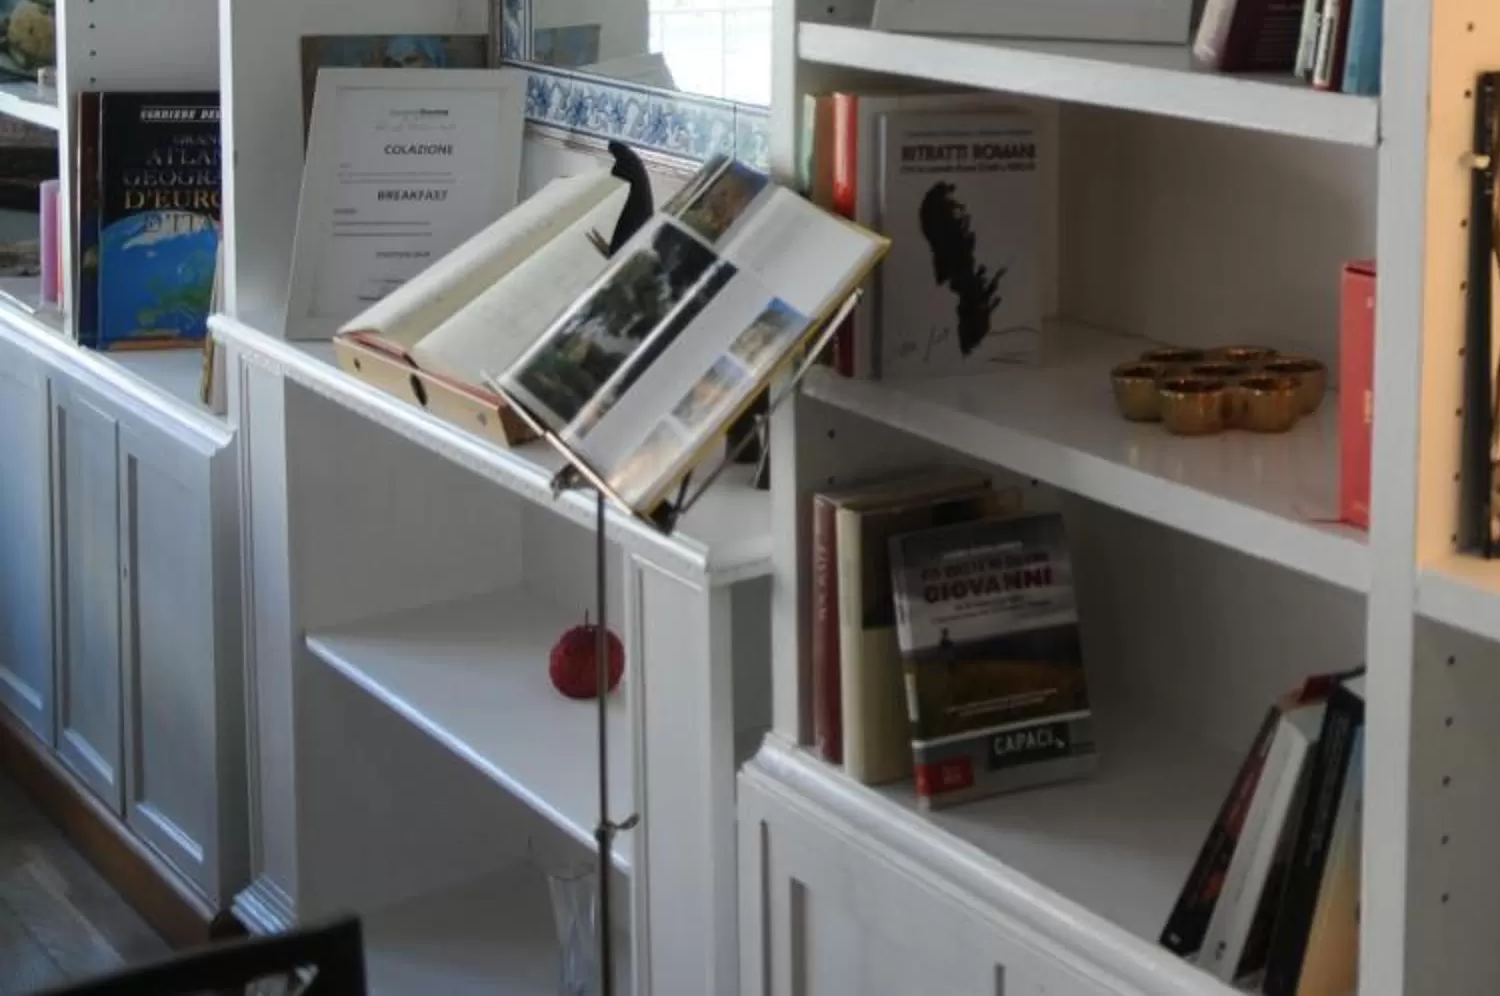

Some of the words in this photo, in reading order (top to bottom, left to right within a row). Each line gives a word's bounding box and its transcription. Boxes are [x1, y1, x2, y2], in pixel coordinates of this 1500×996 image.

[383, 143, 454, 156] COLAZIONE
[122, 167, 221, 186] GEOGR
[923, 564, 1053, 604] GIOVANNI
